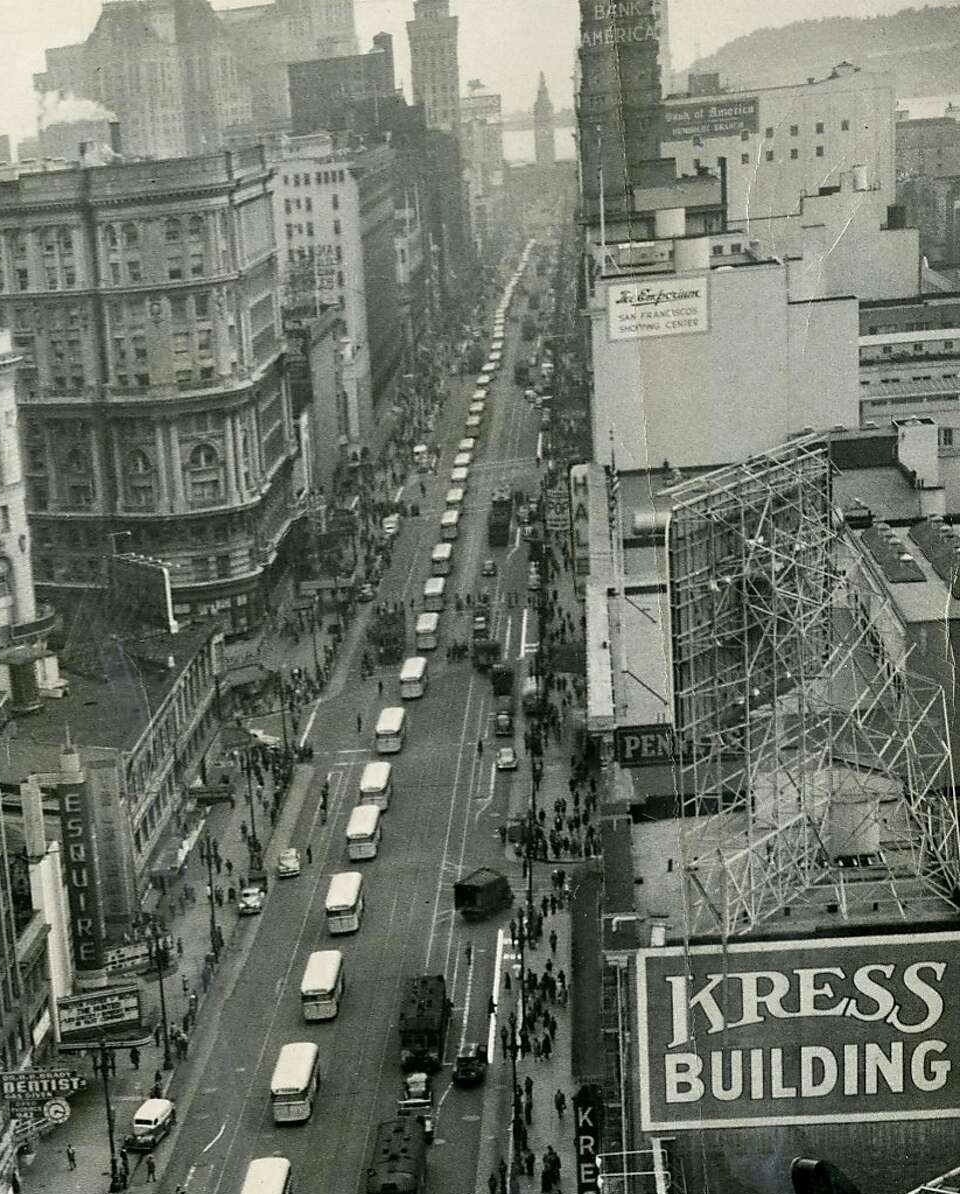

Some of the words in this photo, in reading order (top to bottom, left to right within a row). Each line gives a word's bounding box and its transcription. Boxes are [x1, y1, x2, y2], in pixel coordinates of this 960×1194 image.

[594, 2, 641, 20] BANK
[582, 23, 655, 46] AMERICA
[708, 105, 754, 119] America
[637, 288, 701, 306] Emporium
[65, 793, 96, 961] ESQUIRE
[665, 961, 948, 1049] KRESS
[664, 1040, 951, 1104] BUILDING
